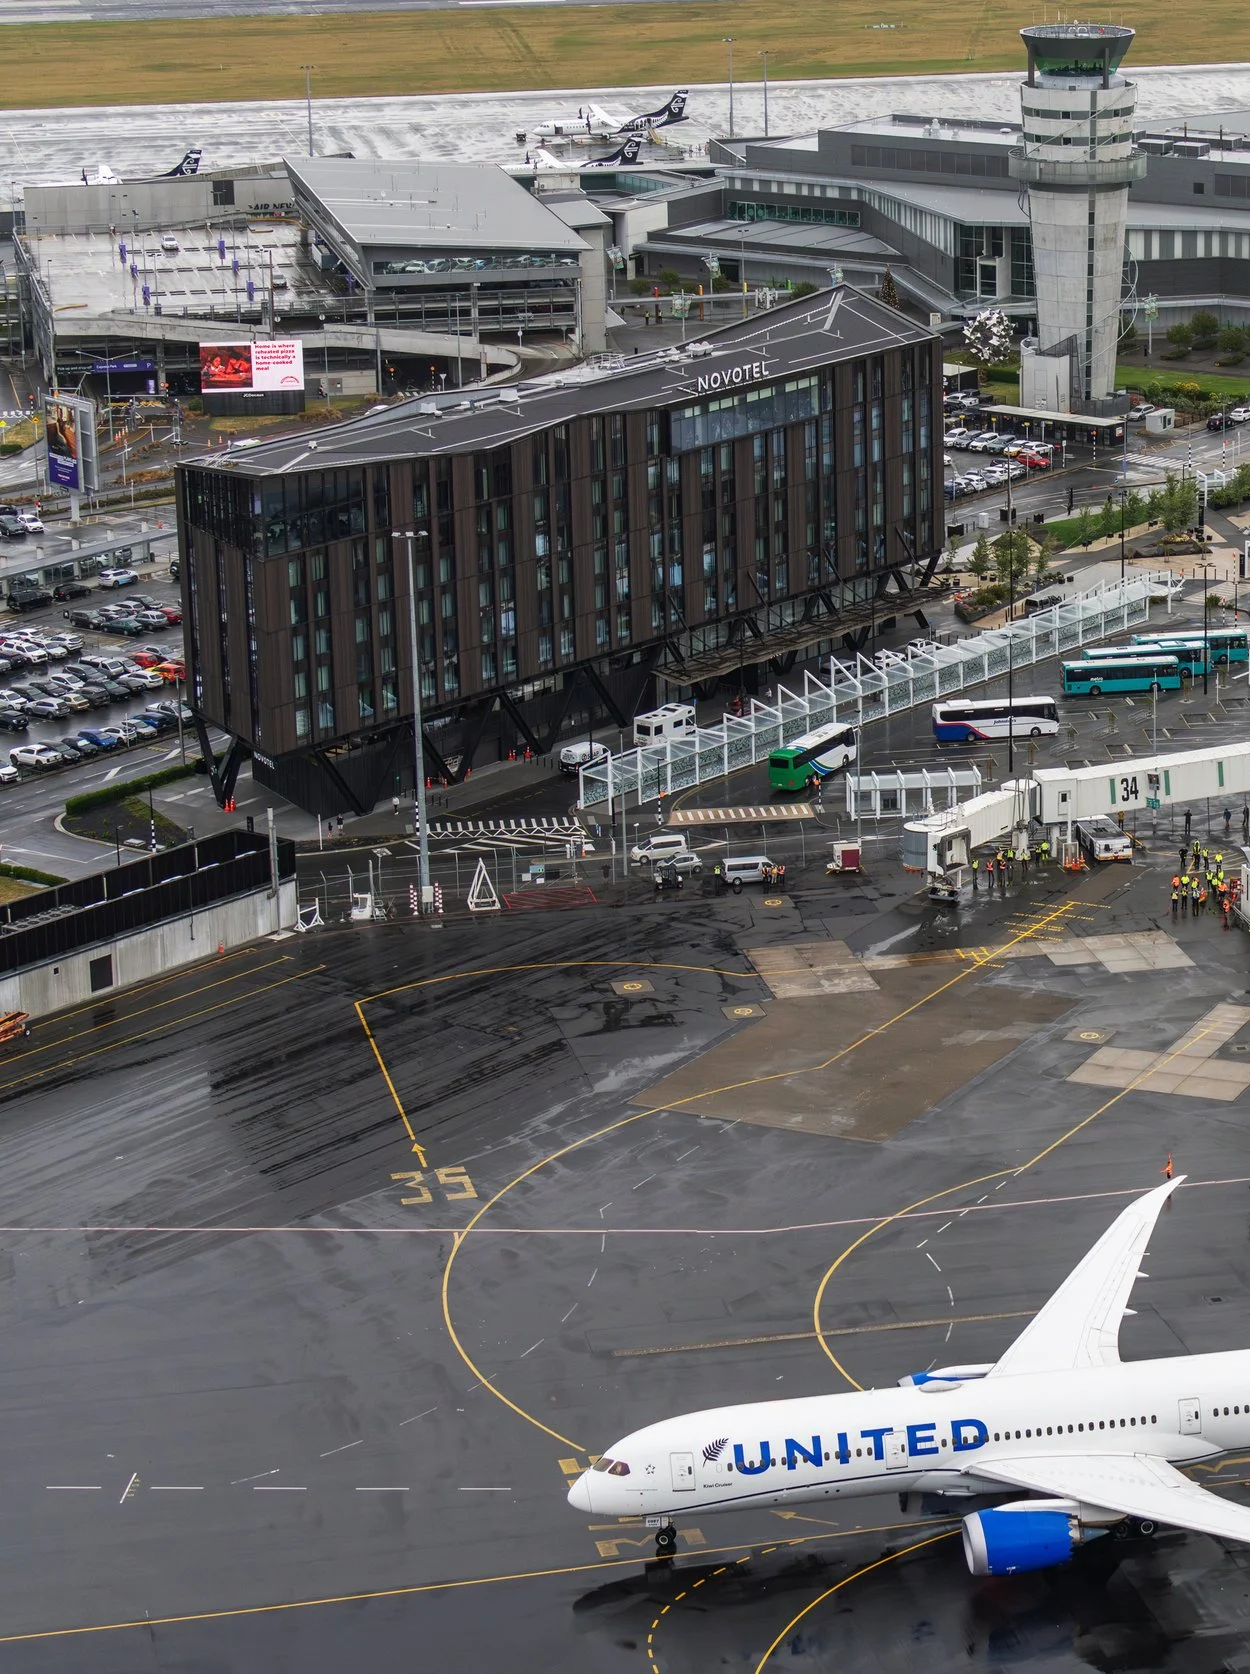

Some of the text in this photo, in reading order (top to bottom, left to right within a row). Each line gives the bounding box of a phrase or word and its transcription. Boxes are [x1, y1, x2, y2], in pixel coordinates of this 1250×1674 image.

[697, 360, 770, 392] NOVOTEL
[1120, 776, 1140, 802] 34
[390, 1166, 478, 1205] 35
[733, 1418, 990, 1476] UNITED
